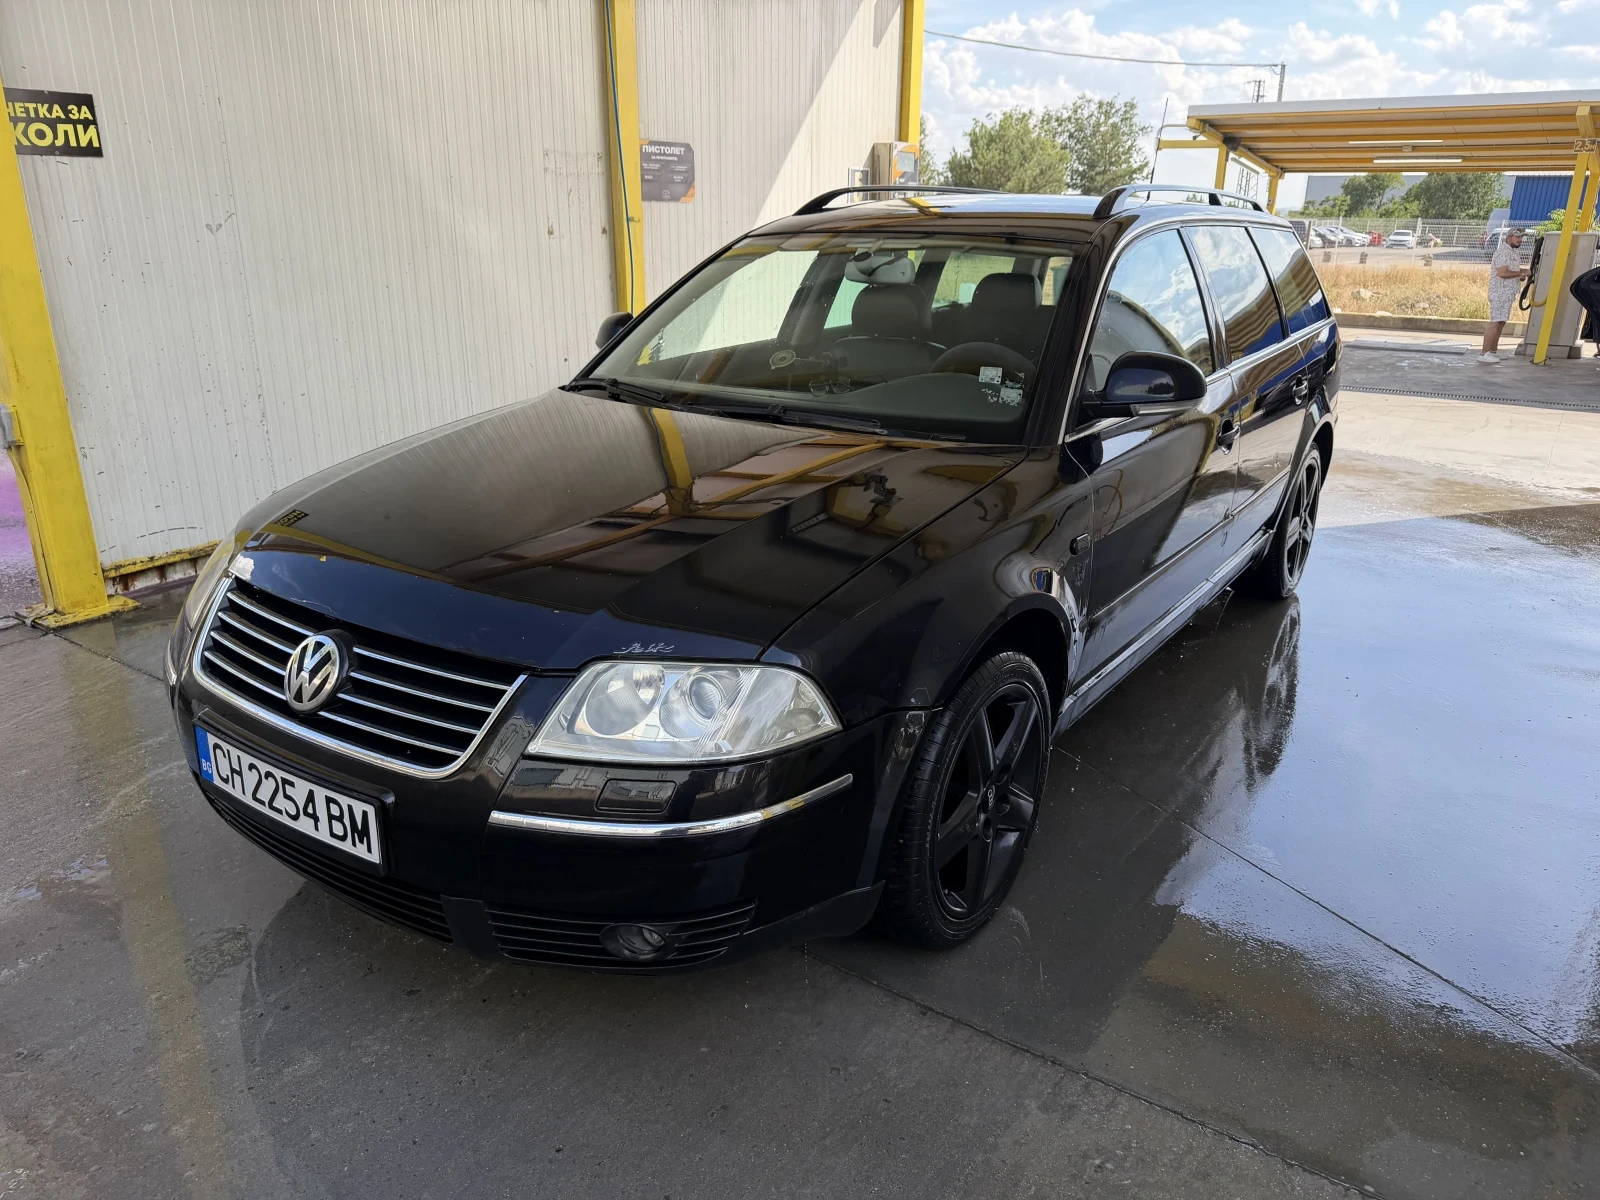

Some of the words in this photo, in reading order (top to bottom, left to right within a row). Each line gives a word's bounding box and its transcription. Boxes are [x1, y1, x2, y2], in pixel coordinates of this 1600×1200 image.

[67, 105, 94, 120] ЗА
[11, 122, 100, 147] КОЛИ
[642, 145, 685, 155] ПИСТОЛЕТ
[201, 758, 212, 773] BG
[247, 762, 320, 832] 2254
